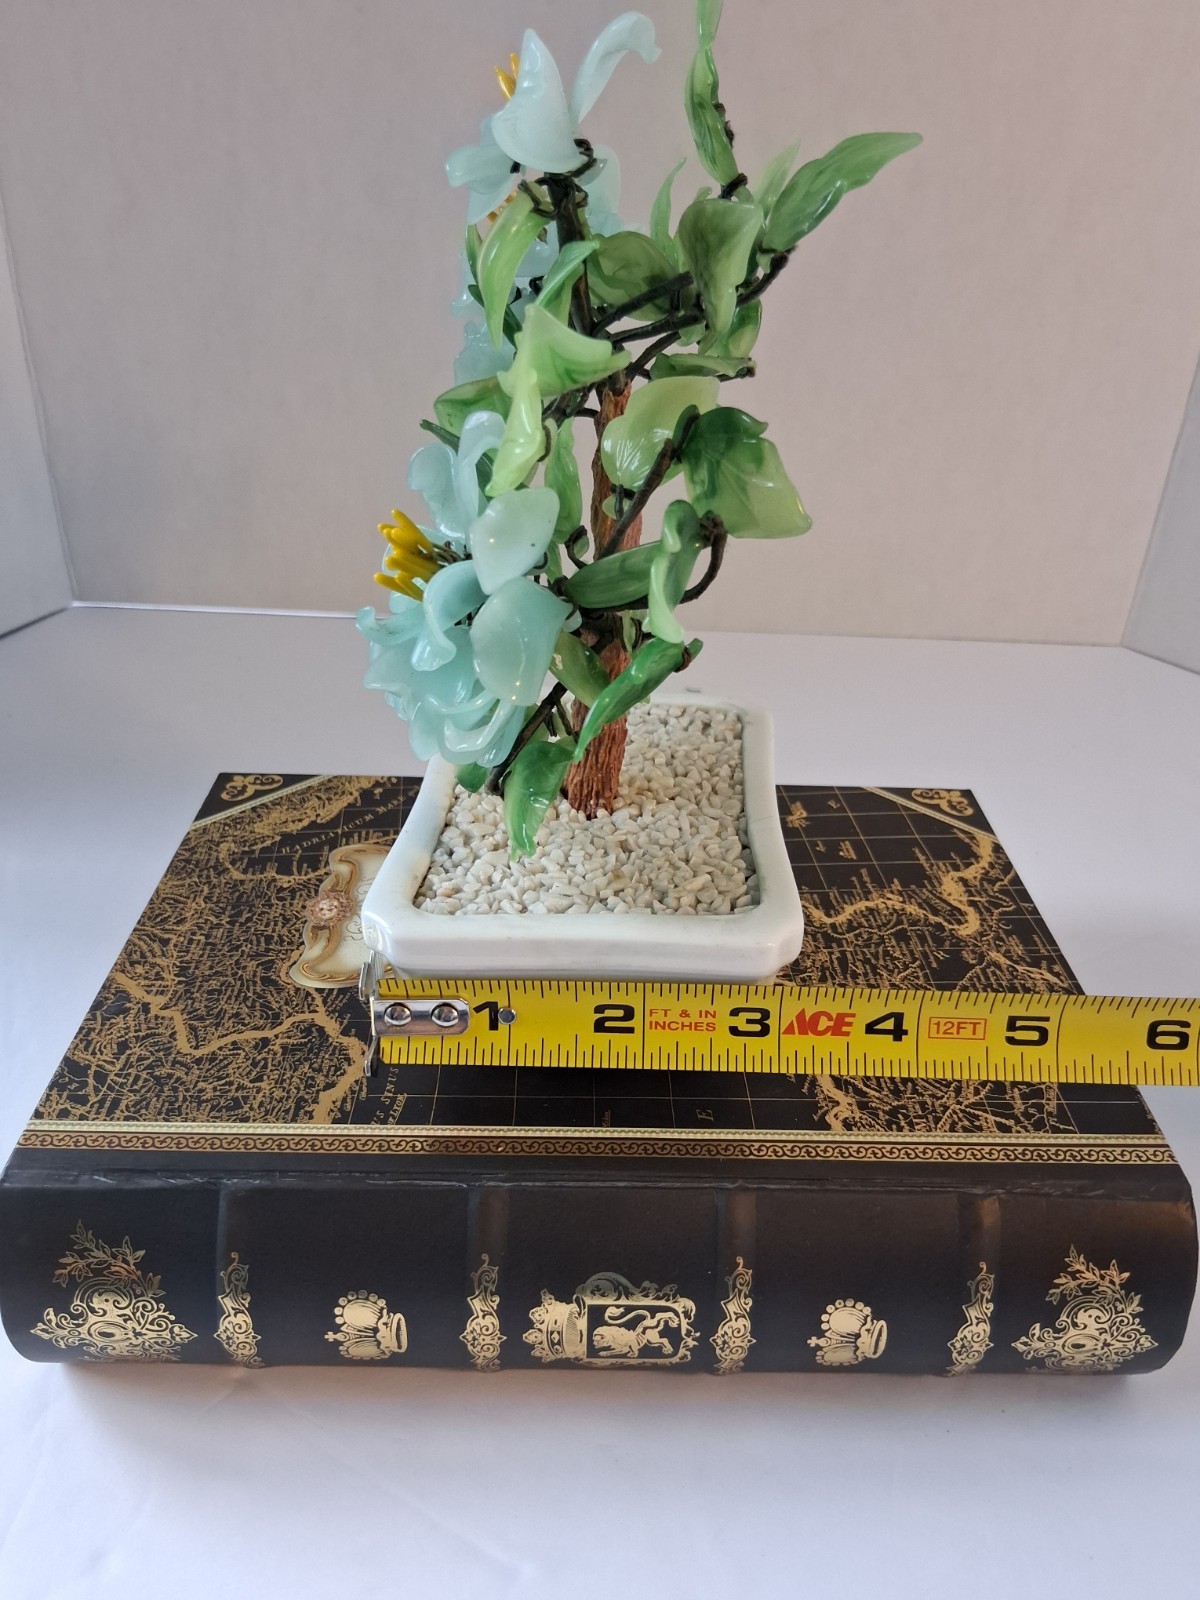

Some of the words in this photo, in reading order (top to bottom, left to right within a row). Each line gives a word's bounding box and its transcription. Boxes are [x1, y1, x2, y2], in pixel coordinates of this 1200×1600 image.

[473, 1001, 499, 1031] 1
[593, 1003, 635, 1034] 2
[649, 1008, 671, 1018] FT
[679, 1008, 691, 1018] &
[699, 1009, 717, 1019] IN
[649, 1020, 717, 1032] INCHES
[728, 1006, 771, 1037] 3
[781, 1007, 857, 1037] ACE
[864, 1011, 909, 1042] 4
[932, 1020, 981, 1036] 12FT
[1004, 1015, 1051, 1046] 5
[1146, 1019, 1192, 1050] 6
[380, 1067, 399, 1105] SINUS
